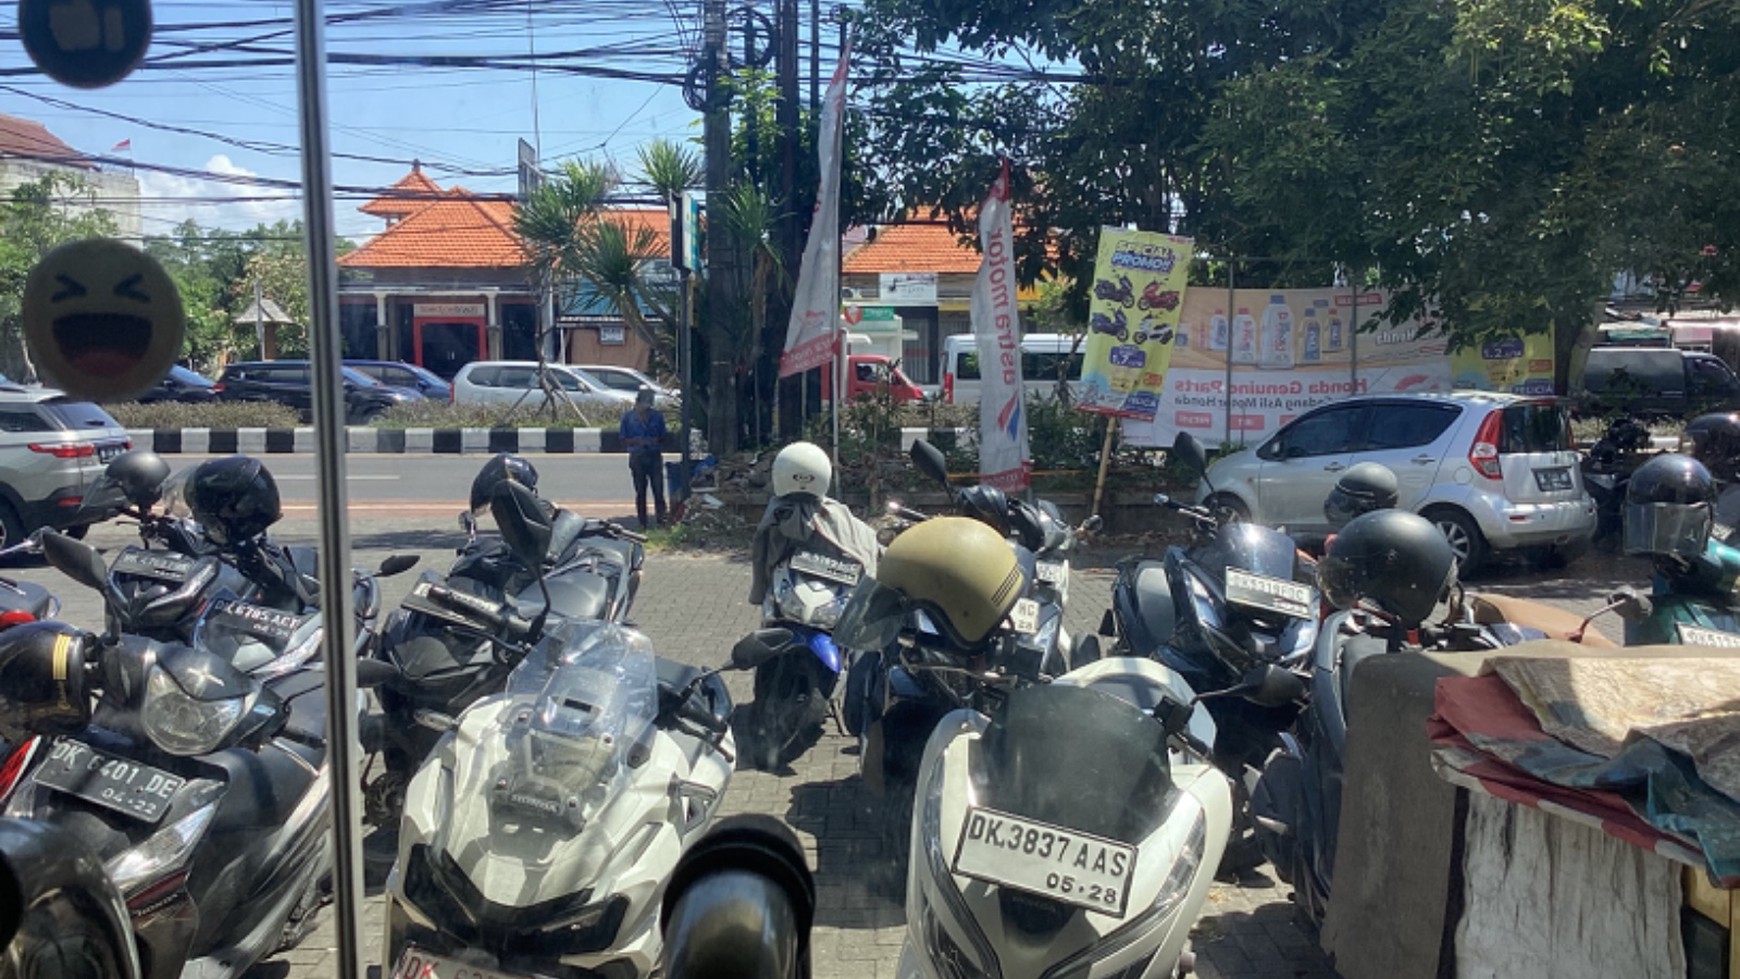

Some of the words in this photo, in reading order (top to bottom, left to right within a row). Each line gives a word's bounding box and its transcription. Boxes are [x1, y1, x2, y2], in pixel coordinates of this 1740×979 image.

[52, 741, 84, 768] DK
[145, 774, 178, 798] DE
[1008, 824, 1071, 863] 3837
[1073, 842, 1127, 877] AAS
